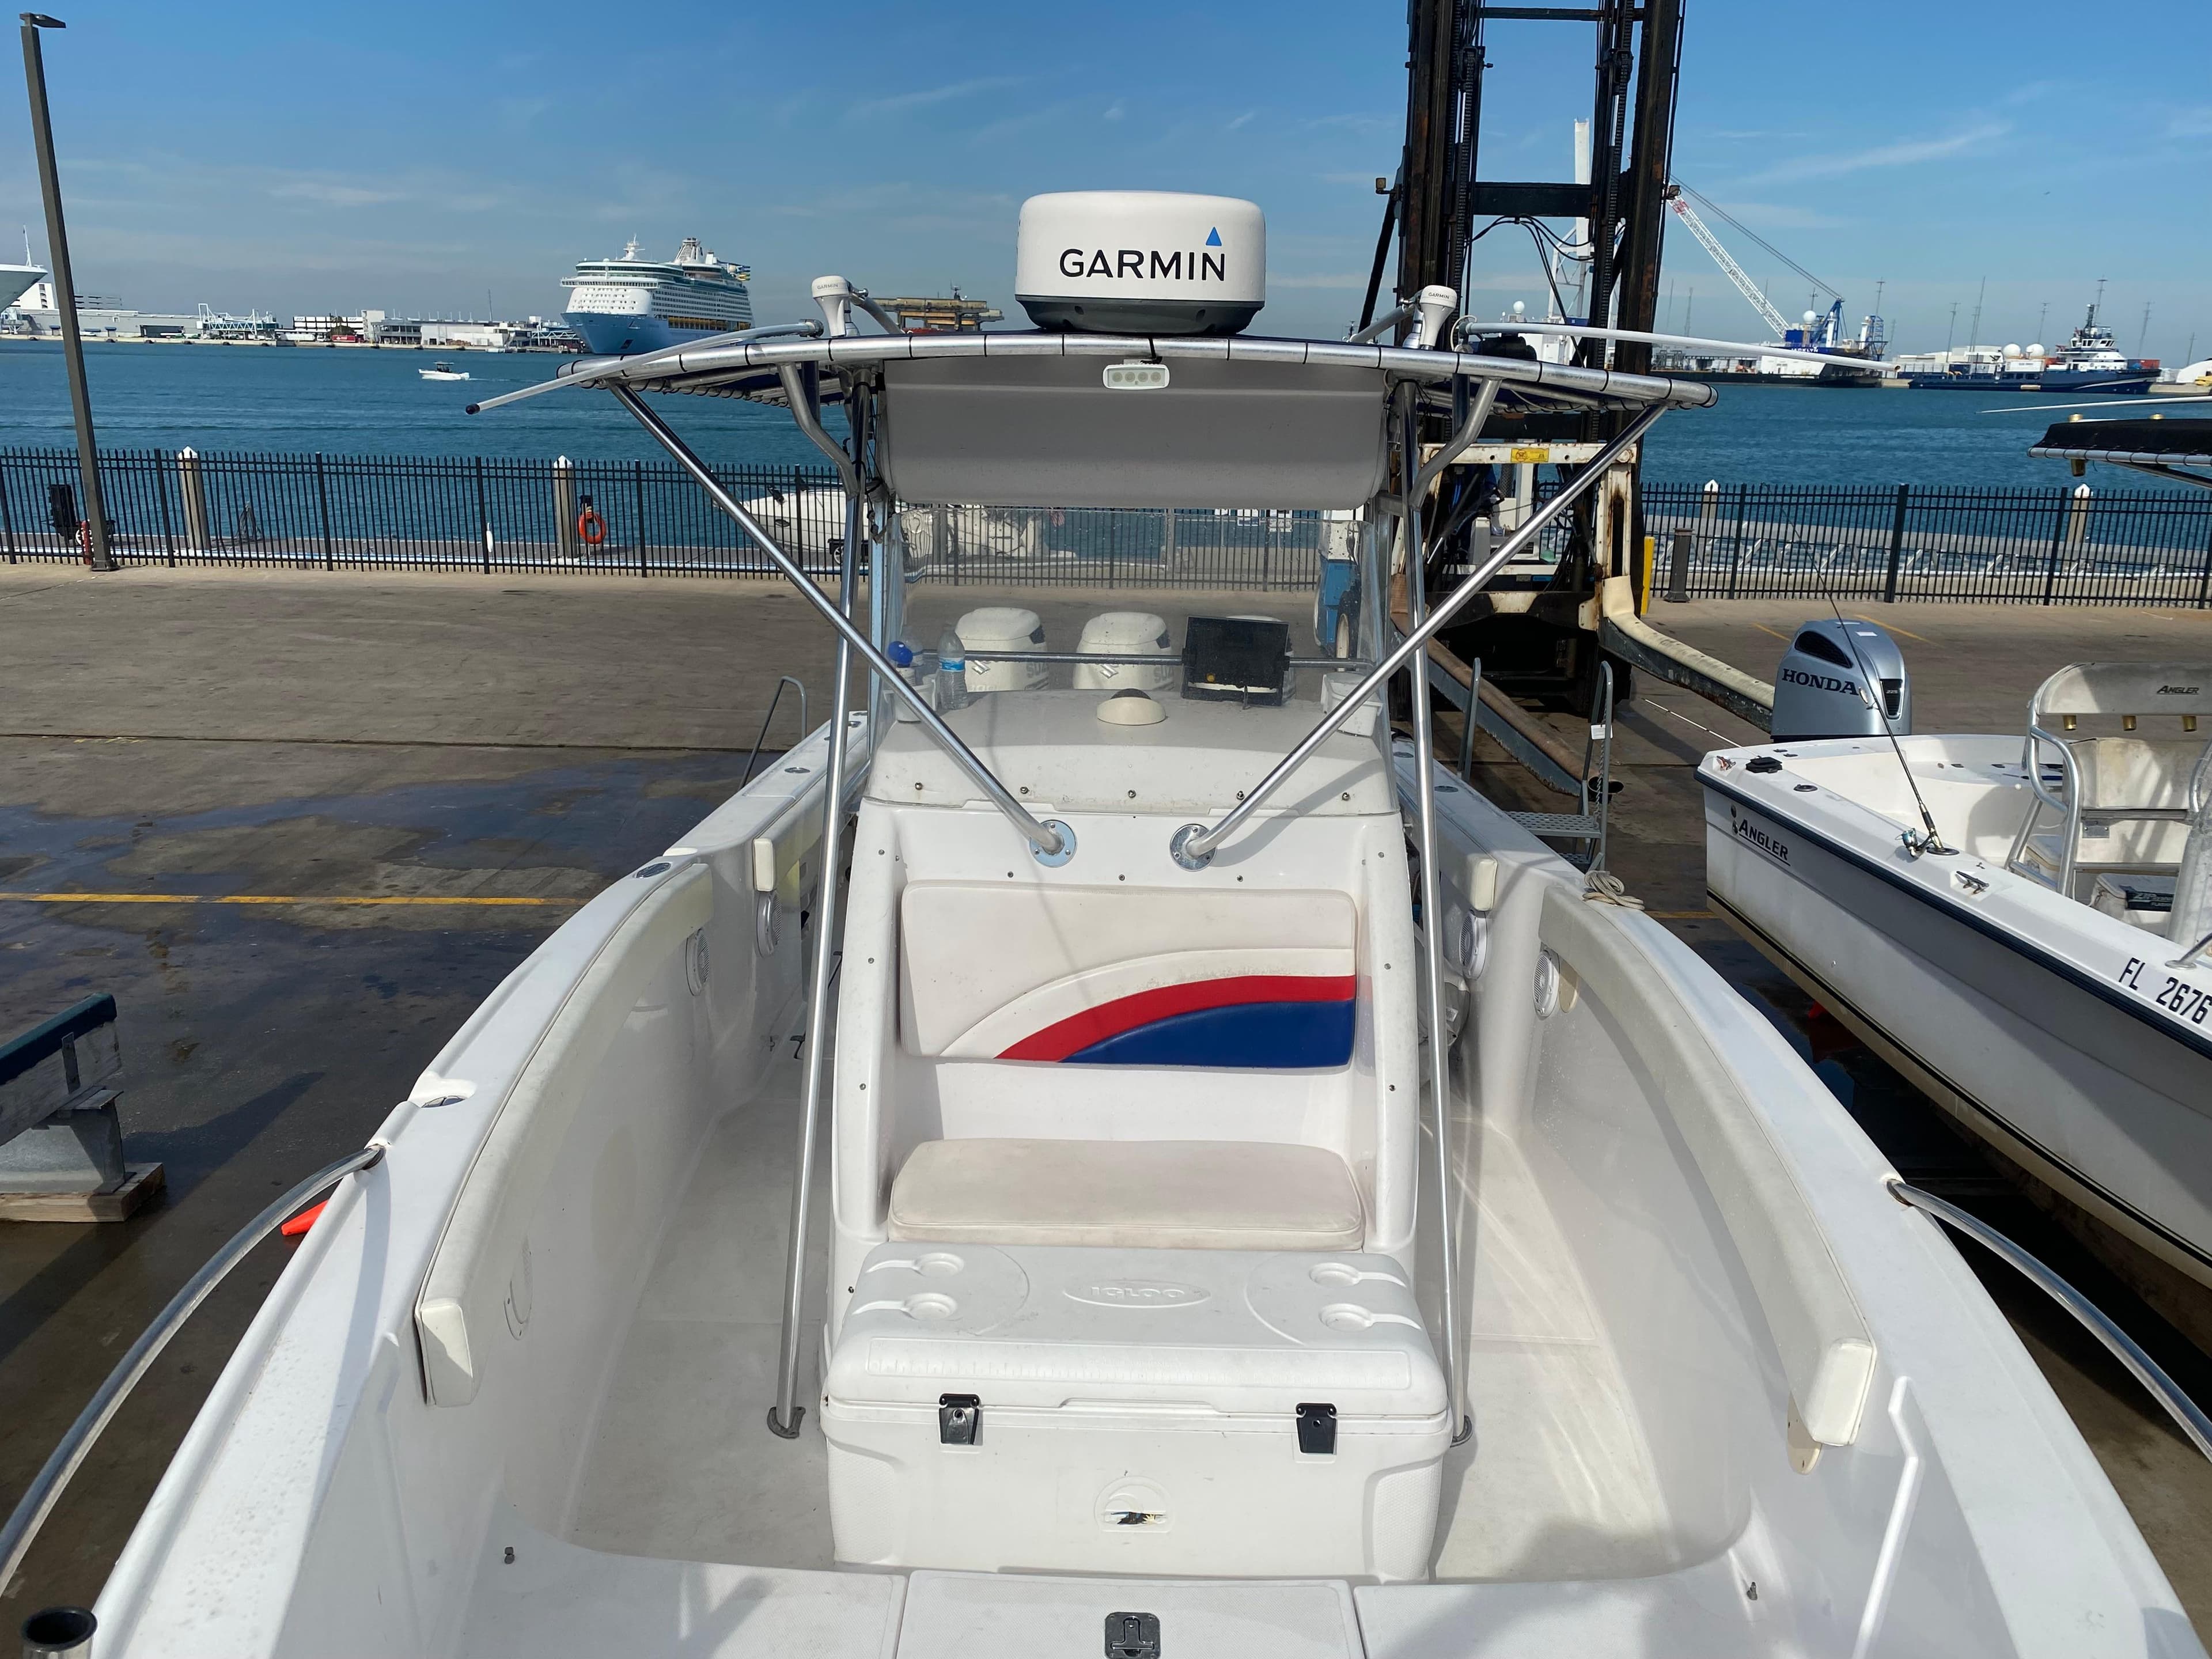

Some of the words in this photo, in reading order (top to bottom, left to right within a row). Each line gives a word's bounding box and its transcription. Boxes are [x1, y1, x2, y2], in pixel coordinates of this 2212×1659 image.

[1059, 248, 1225, 282] GARMIN
[1782, 668, 1859, 696] HONDA
[2156, 685, 2199, 695] ANGLER
[1738, 819, 1789, 861] ANGLER
[2119, 957, 2145, 991] FL
[2156, 976, 2212, 1024] 2676
[1091, 1286, 1185, 1298] IGLOO
